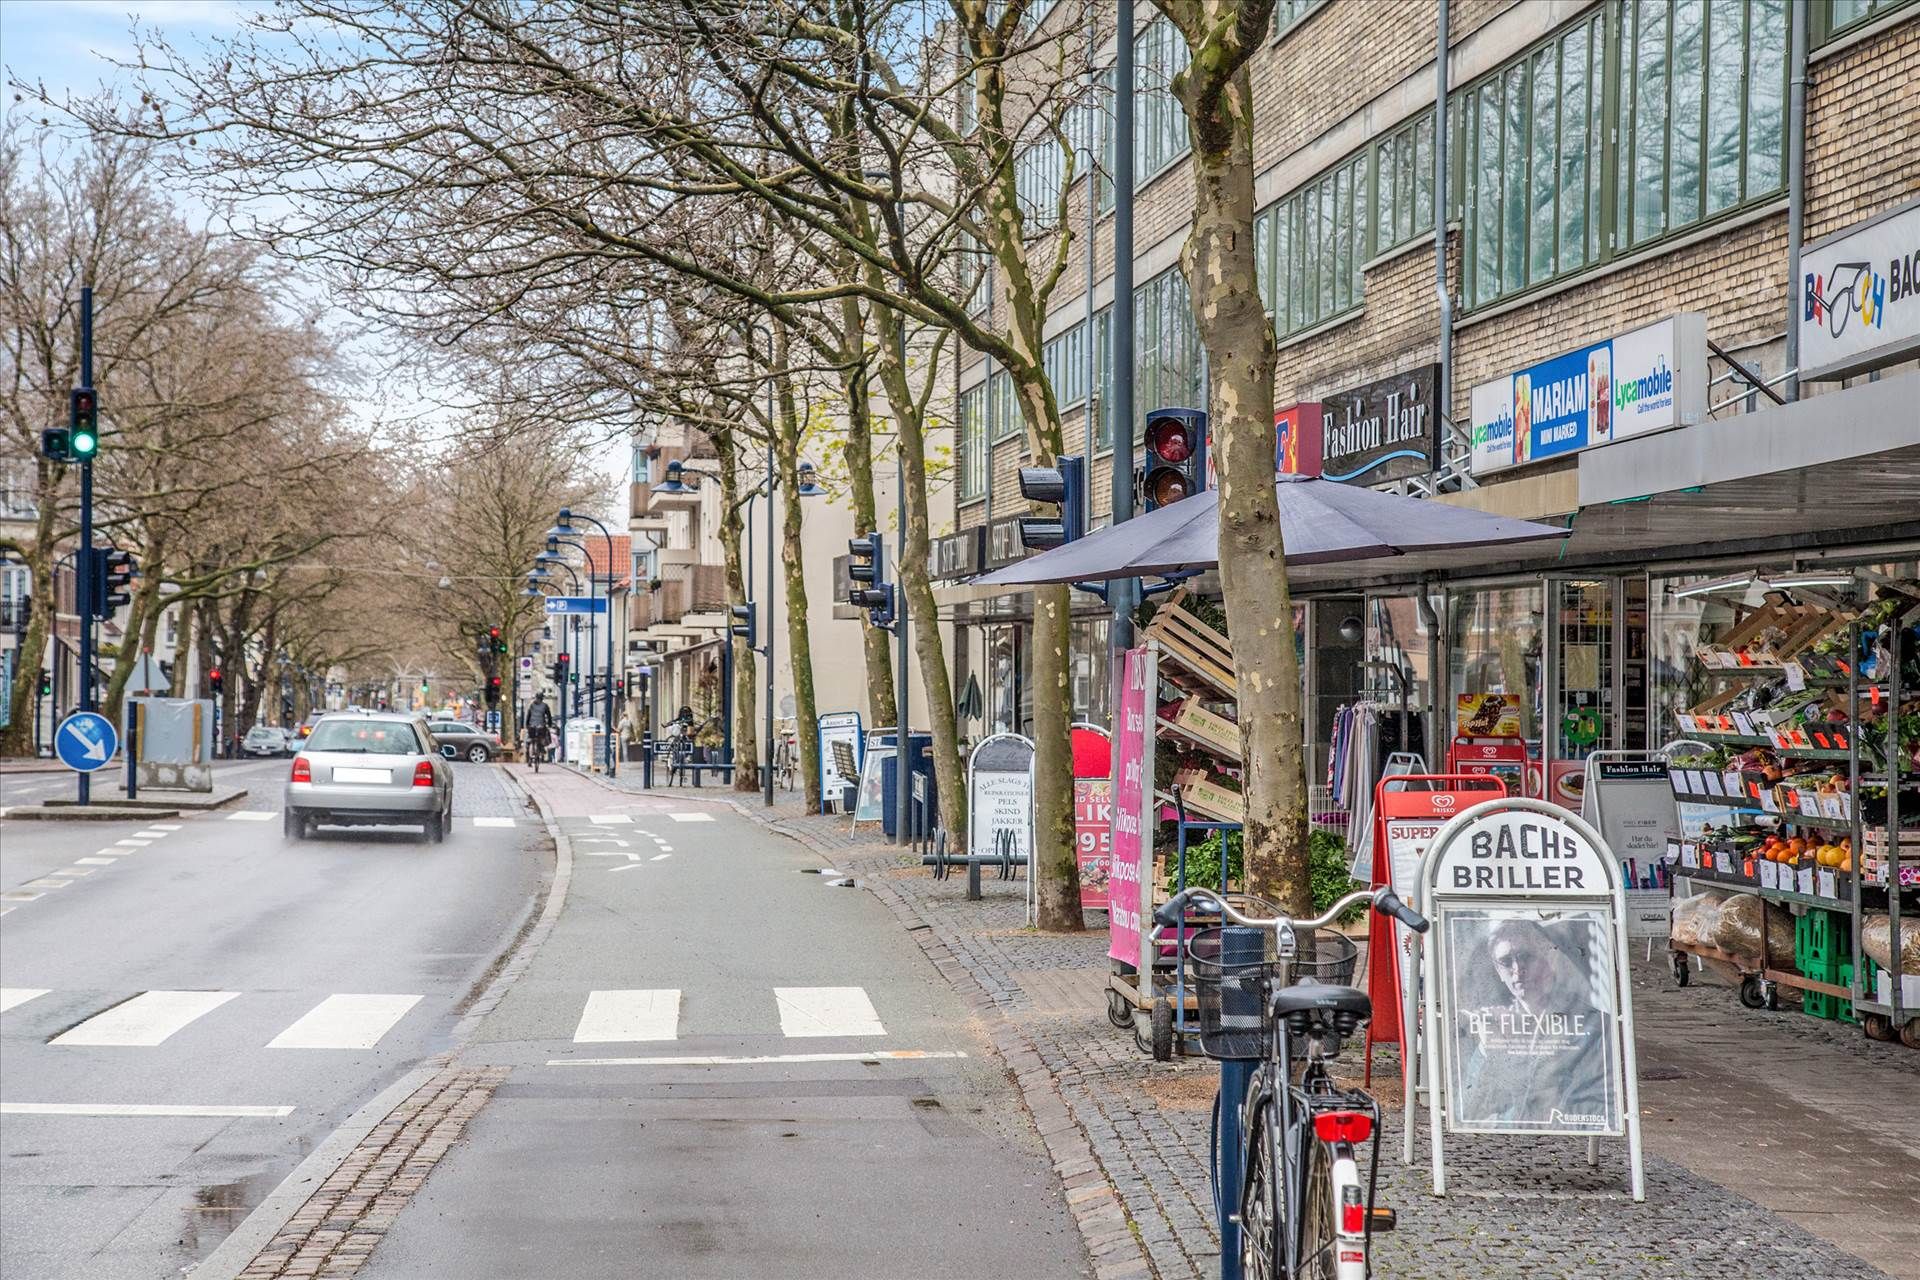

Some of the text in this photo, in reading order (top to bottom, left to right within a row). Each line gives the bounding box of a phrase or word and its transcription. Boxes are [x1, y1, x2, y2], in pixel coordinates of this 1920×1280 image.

[1533, 373, 1586, 425] MARIAM
[1615, 364, 1672, 411] Lycamobile
[1322, 382, 1425, 460] Fashion Hair
[1606, 764, 1661, 773] Fashion Hair
[1453, 865, 1585, 889] BRILLER
[1469, 1013, 1494, 1034] BE
